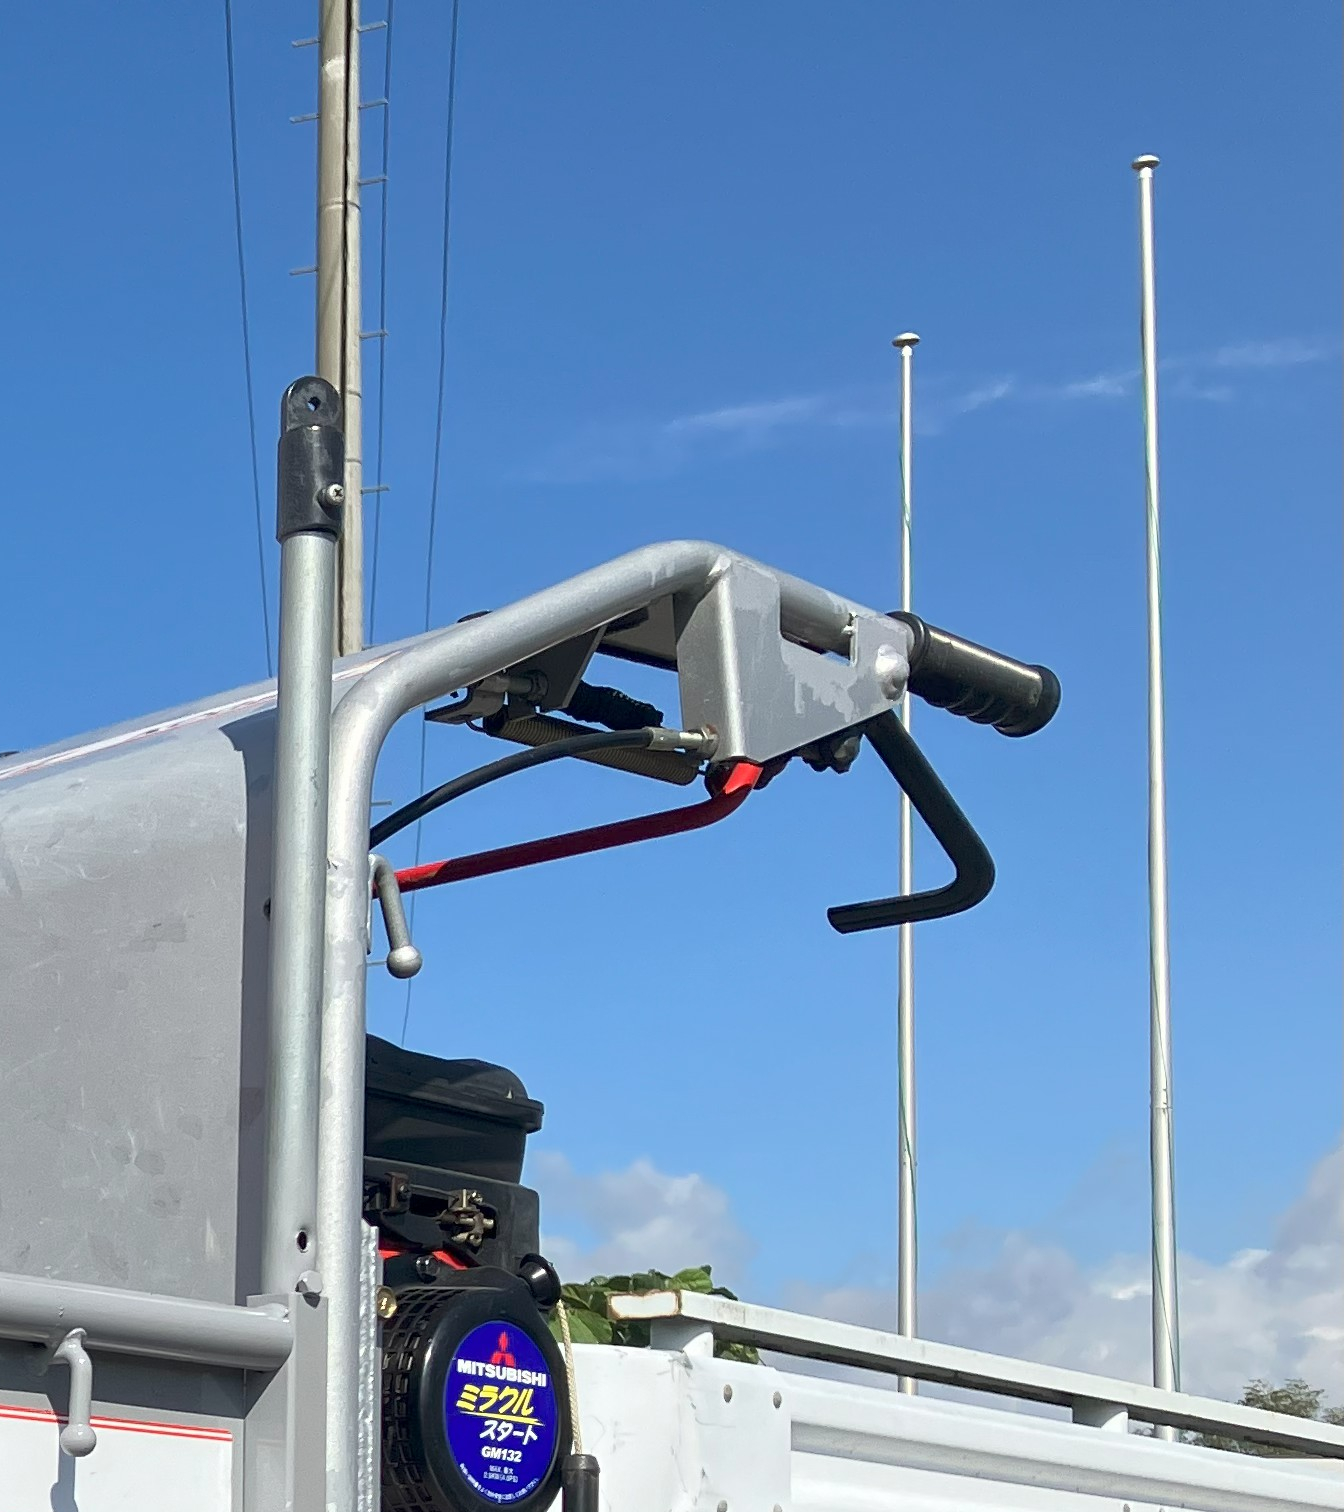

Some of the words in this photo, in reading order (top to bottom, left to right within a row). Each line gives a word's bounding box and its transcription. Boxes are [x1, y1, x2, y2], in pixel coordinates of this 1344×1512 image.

[457, 1359, 546, 1387] MITSUBISHI
[456, 1384, 534, 1416] ミラクル
[479, 1420, 538, 1445] スタート
[481, 1446, 522, 1463] GM132
